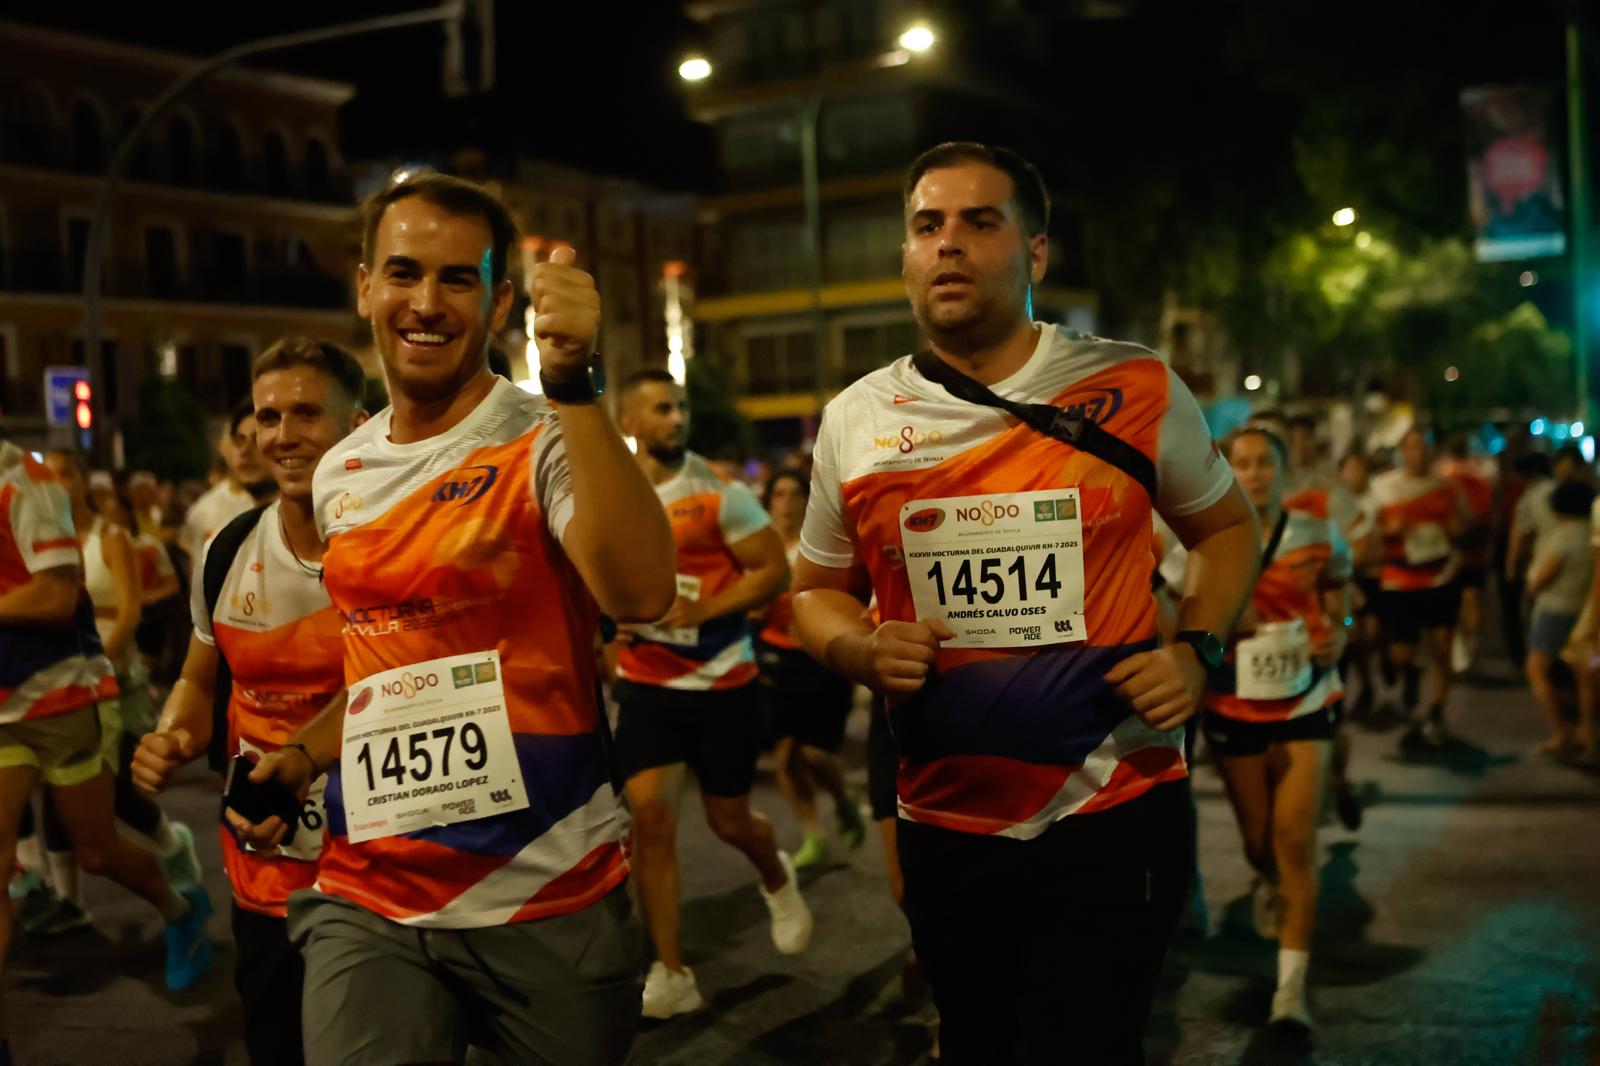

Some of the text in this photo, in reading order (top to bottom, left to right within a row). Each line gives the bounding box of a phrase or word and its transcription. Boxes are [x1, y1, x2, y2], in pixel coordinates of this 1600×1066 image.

[931, 549, 970, 557] NOCTURNA
[986, 543, 1041, 554] GUADALQUIVIR
[927, 553, 1062, 606] 14514
[947, 606, 1047, 619] ANDRÉS CALVO OSES
[1009, 626, 1041, 635] POWER
[357, 722, 488, 791] 14579
[367, 775, 489, 806] CRISTIAN DORADO LOPEZ
